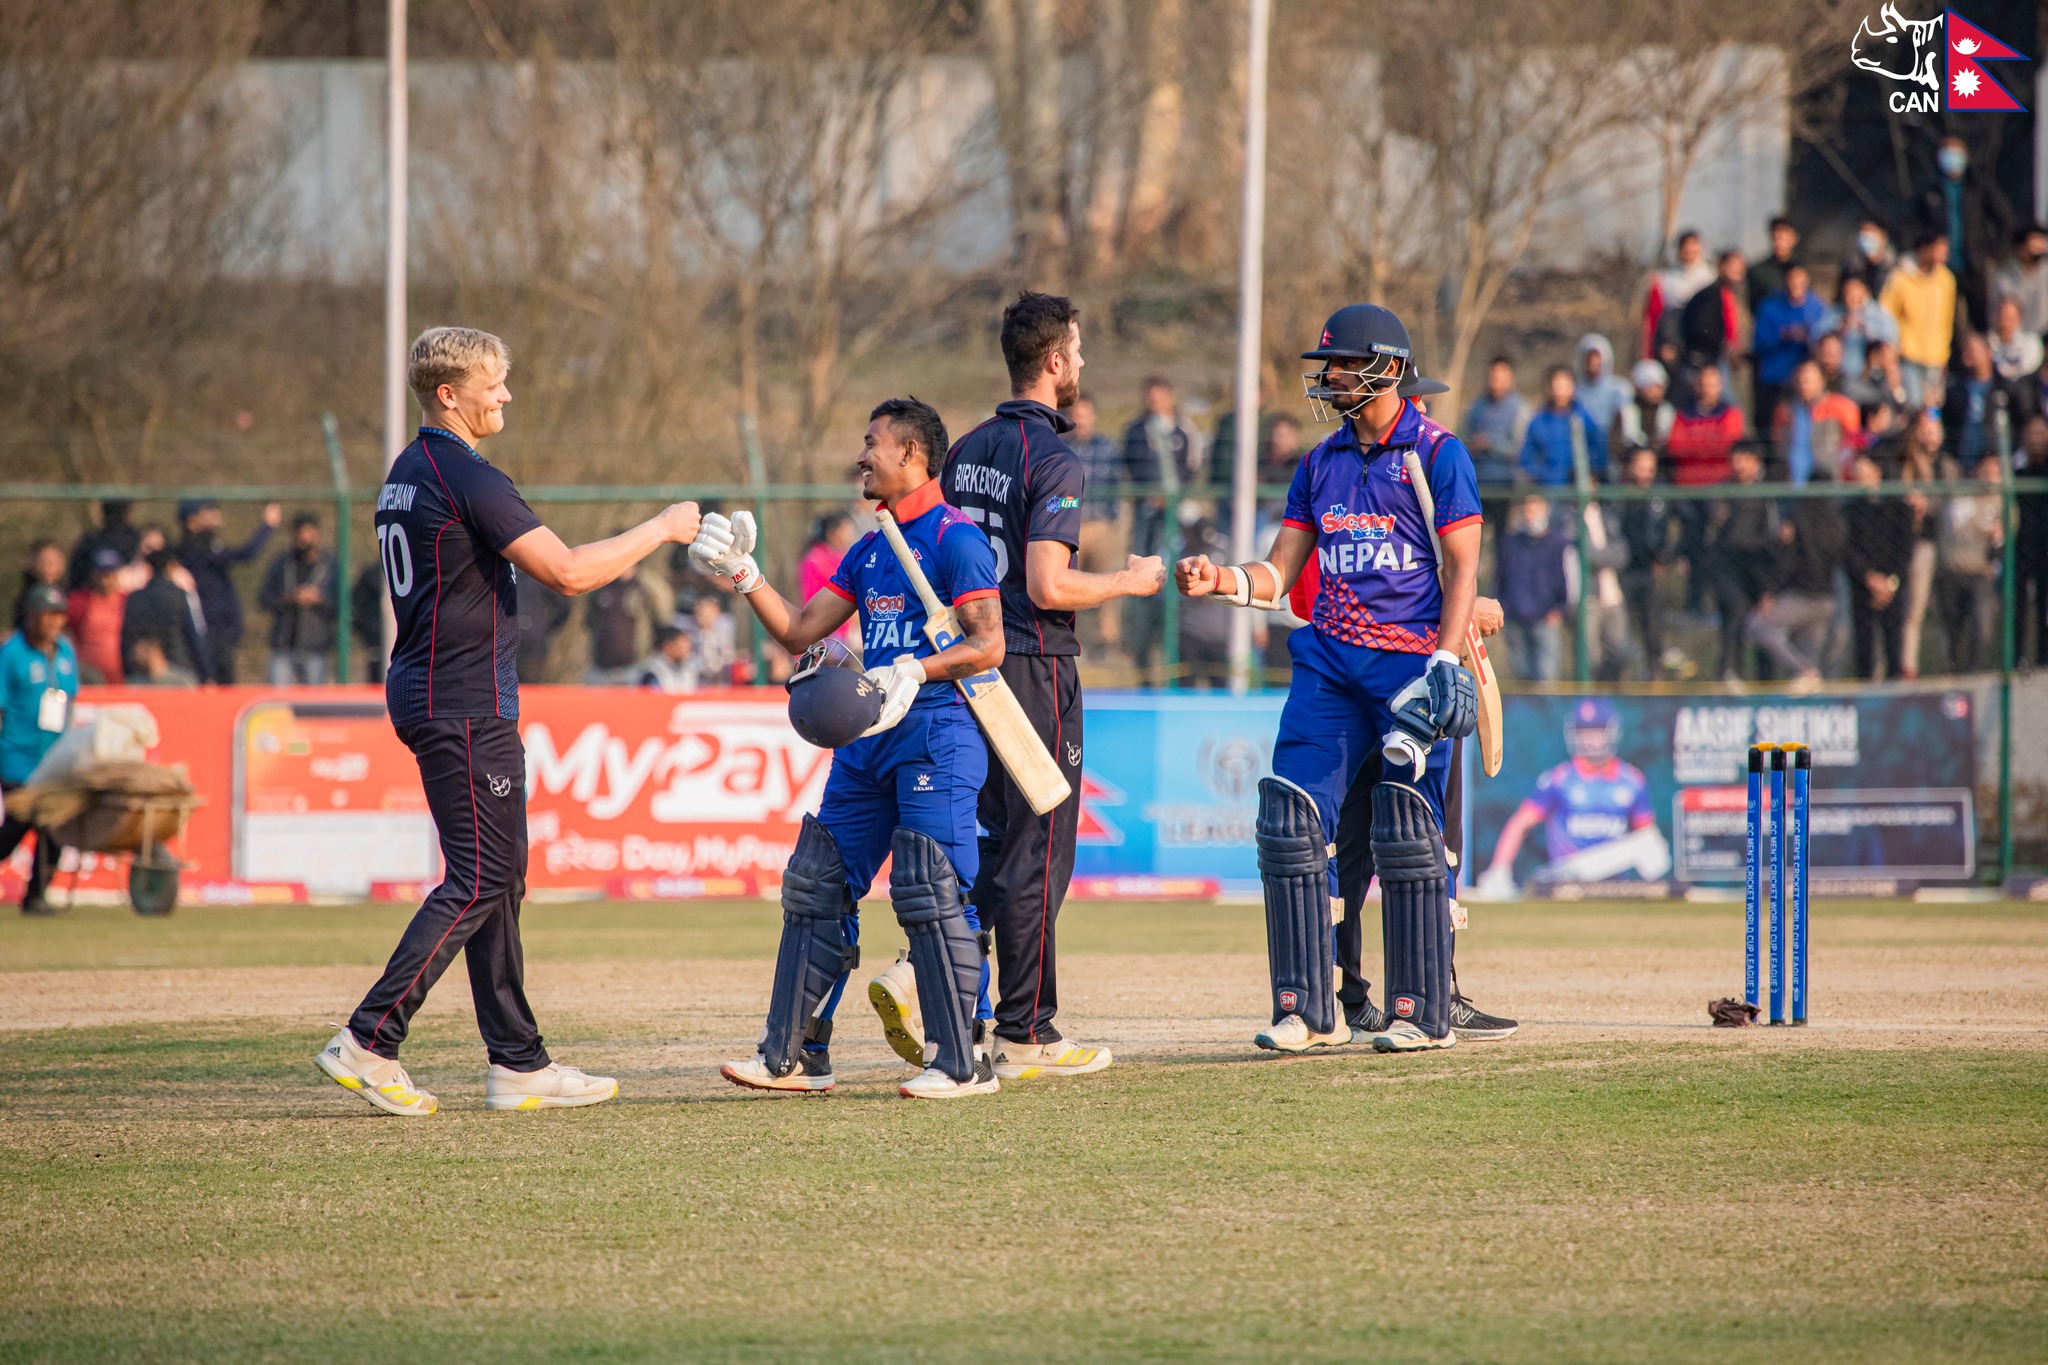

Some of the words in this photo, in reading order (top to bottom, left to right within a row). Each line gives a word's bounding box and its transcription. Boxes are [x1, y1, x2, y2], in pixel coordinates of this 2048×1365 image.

[1351, 529, 1386, 539] Teacher
[377, 523, 413, 597] 70
[1318, 542, 1418, 575] NEPAL
[731, 569, 749, 584] ZAP
[524, 722, 830, 823] MyPay
[1746, 822, 1755, 837] ICC
[1746, 838, 1755, 863] MEN'S
[1746, 865, 1755, 901] CRICKET
[1746, 902, 1755, 934] WORLD
[1746, 935, 1755, 953] CUP
[1746, 954, 1755, 988] LEAGUE
[1281, 995, 1295, 1005] SM
[1397, 1001, 1412, 1013] SM
